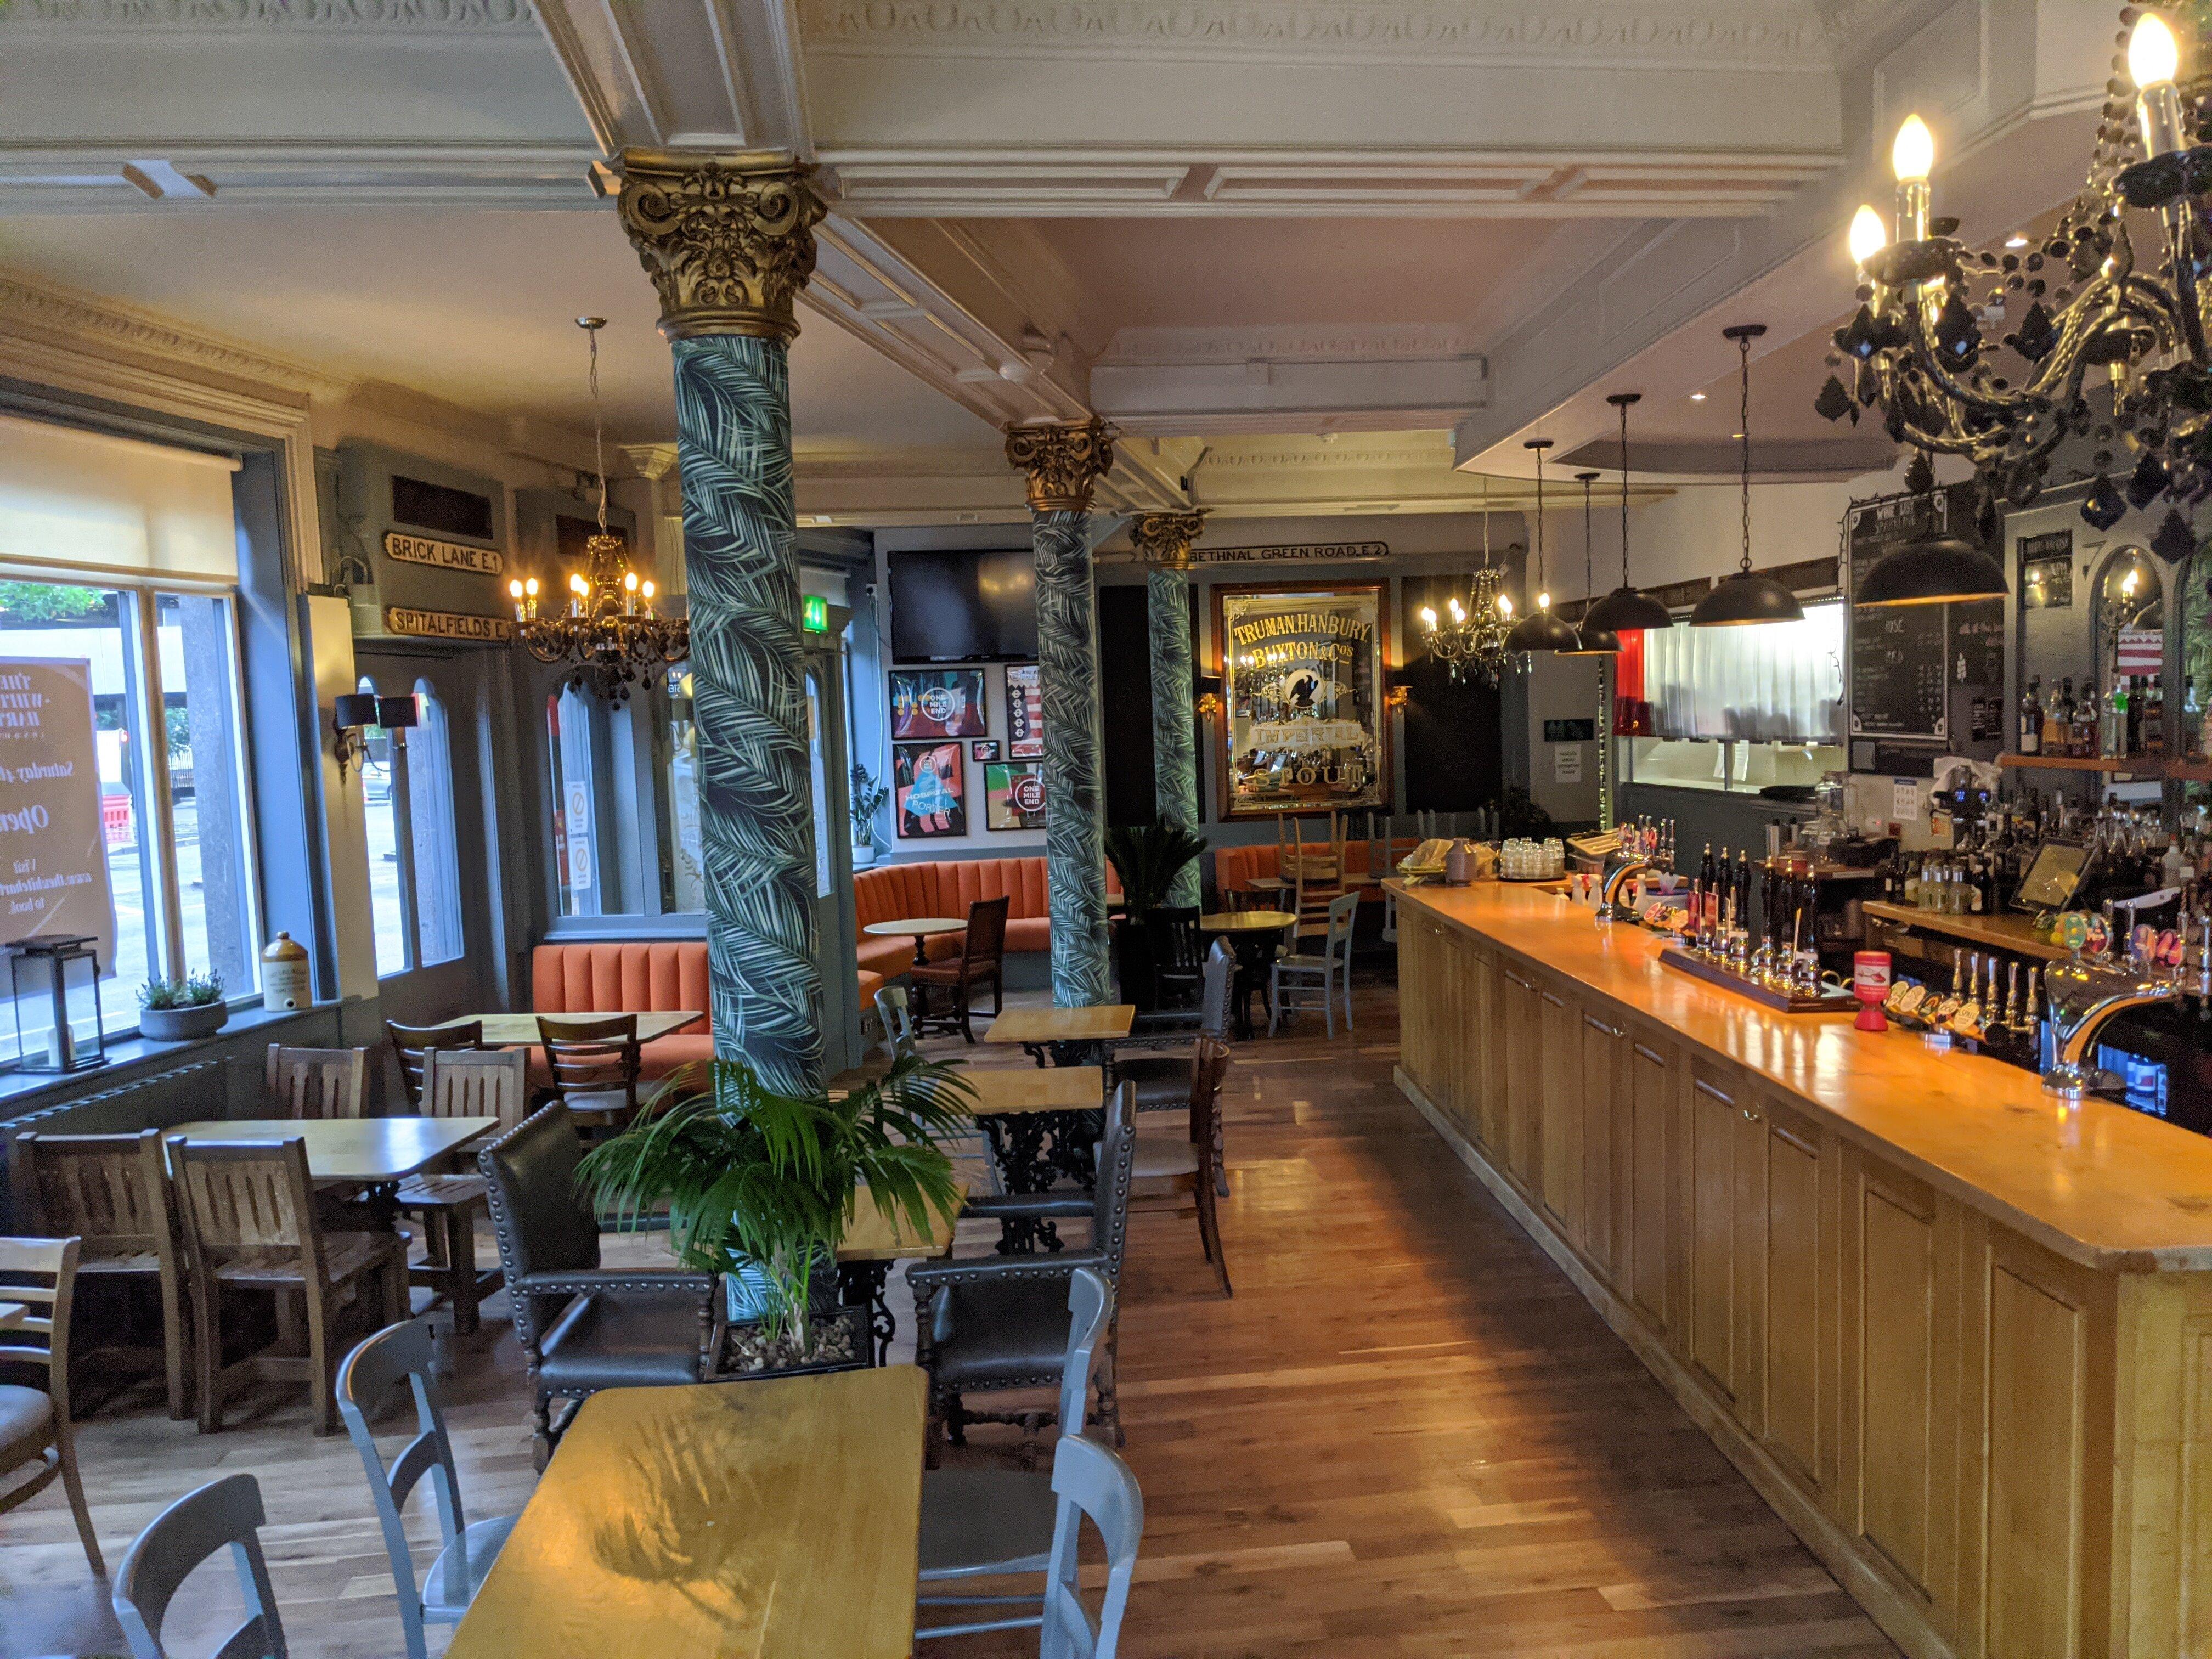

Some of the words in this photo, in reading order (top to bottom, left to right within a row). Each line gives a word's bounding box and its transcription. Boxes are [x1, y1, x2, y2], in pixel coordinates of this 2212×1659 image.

[392, 537, 436, 562] BRICK
[442, 546, 477, 567] LANE
[1189, 550, 1255, 562] BETHNAL
[1261, 549, 1310, 560] GREEN
[396, 611, 490, 638] SPITALFIELDS
[1252, 641, 1318, 669] BUXTON
[1318, 646, 1328, 661] &
[1255, 726, 1359, 745] IMPERIAL
[1254, 765, 1364, 788] STOUT
[905, 788, 955, 801] HOSPITAL
[912, 799, 951, 820] PORTER
